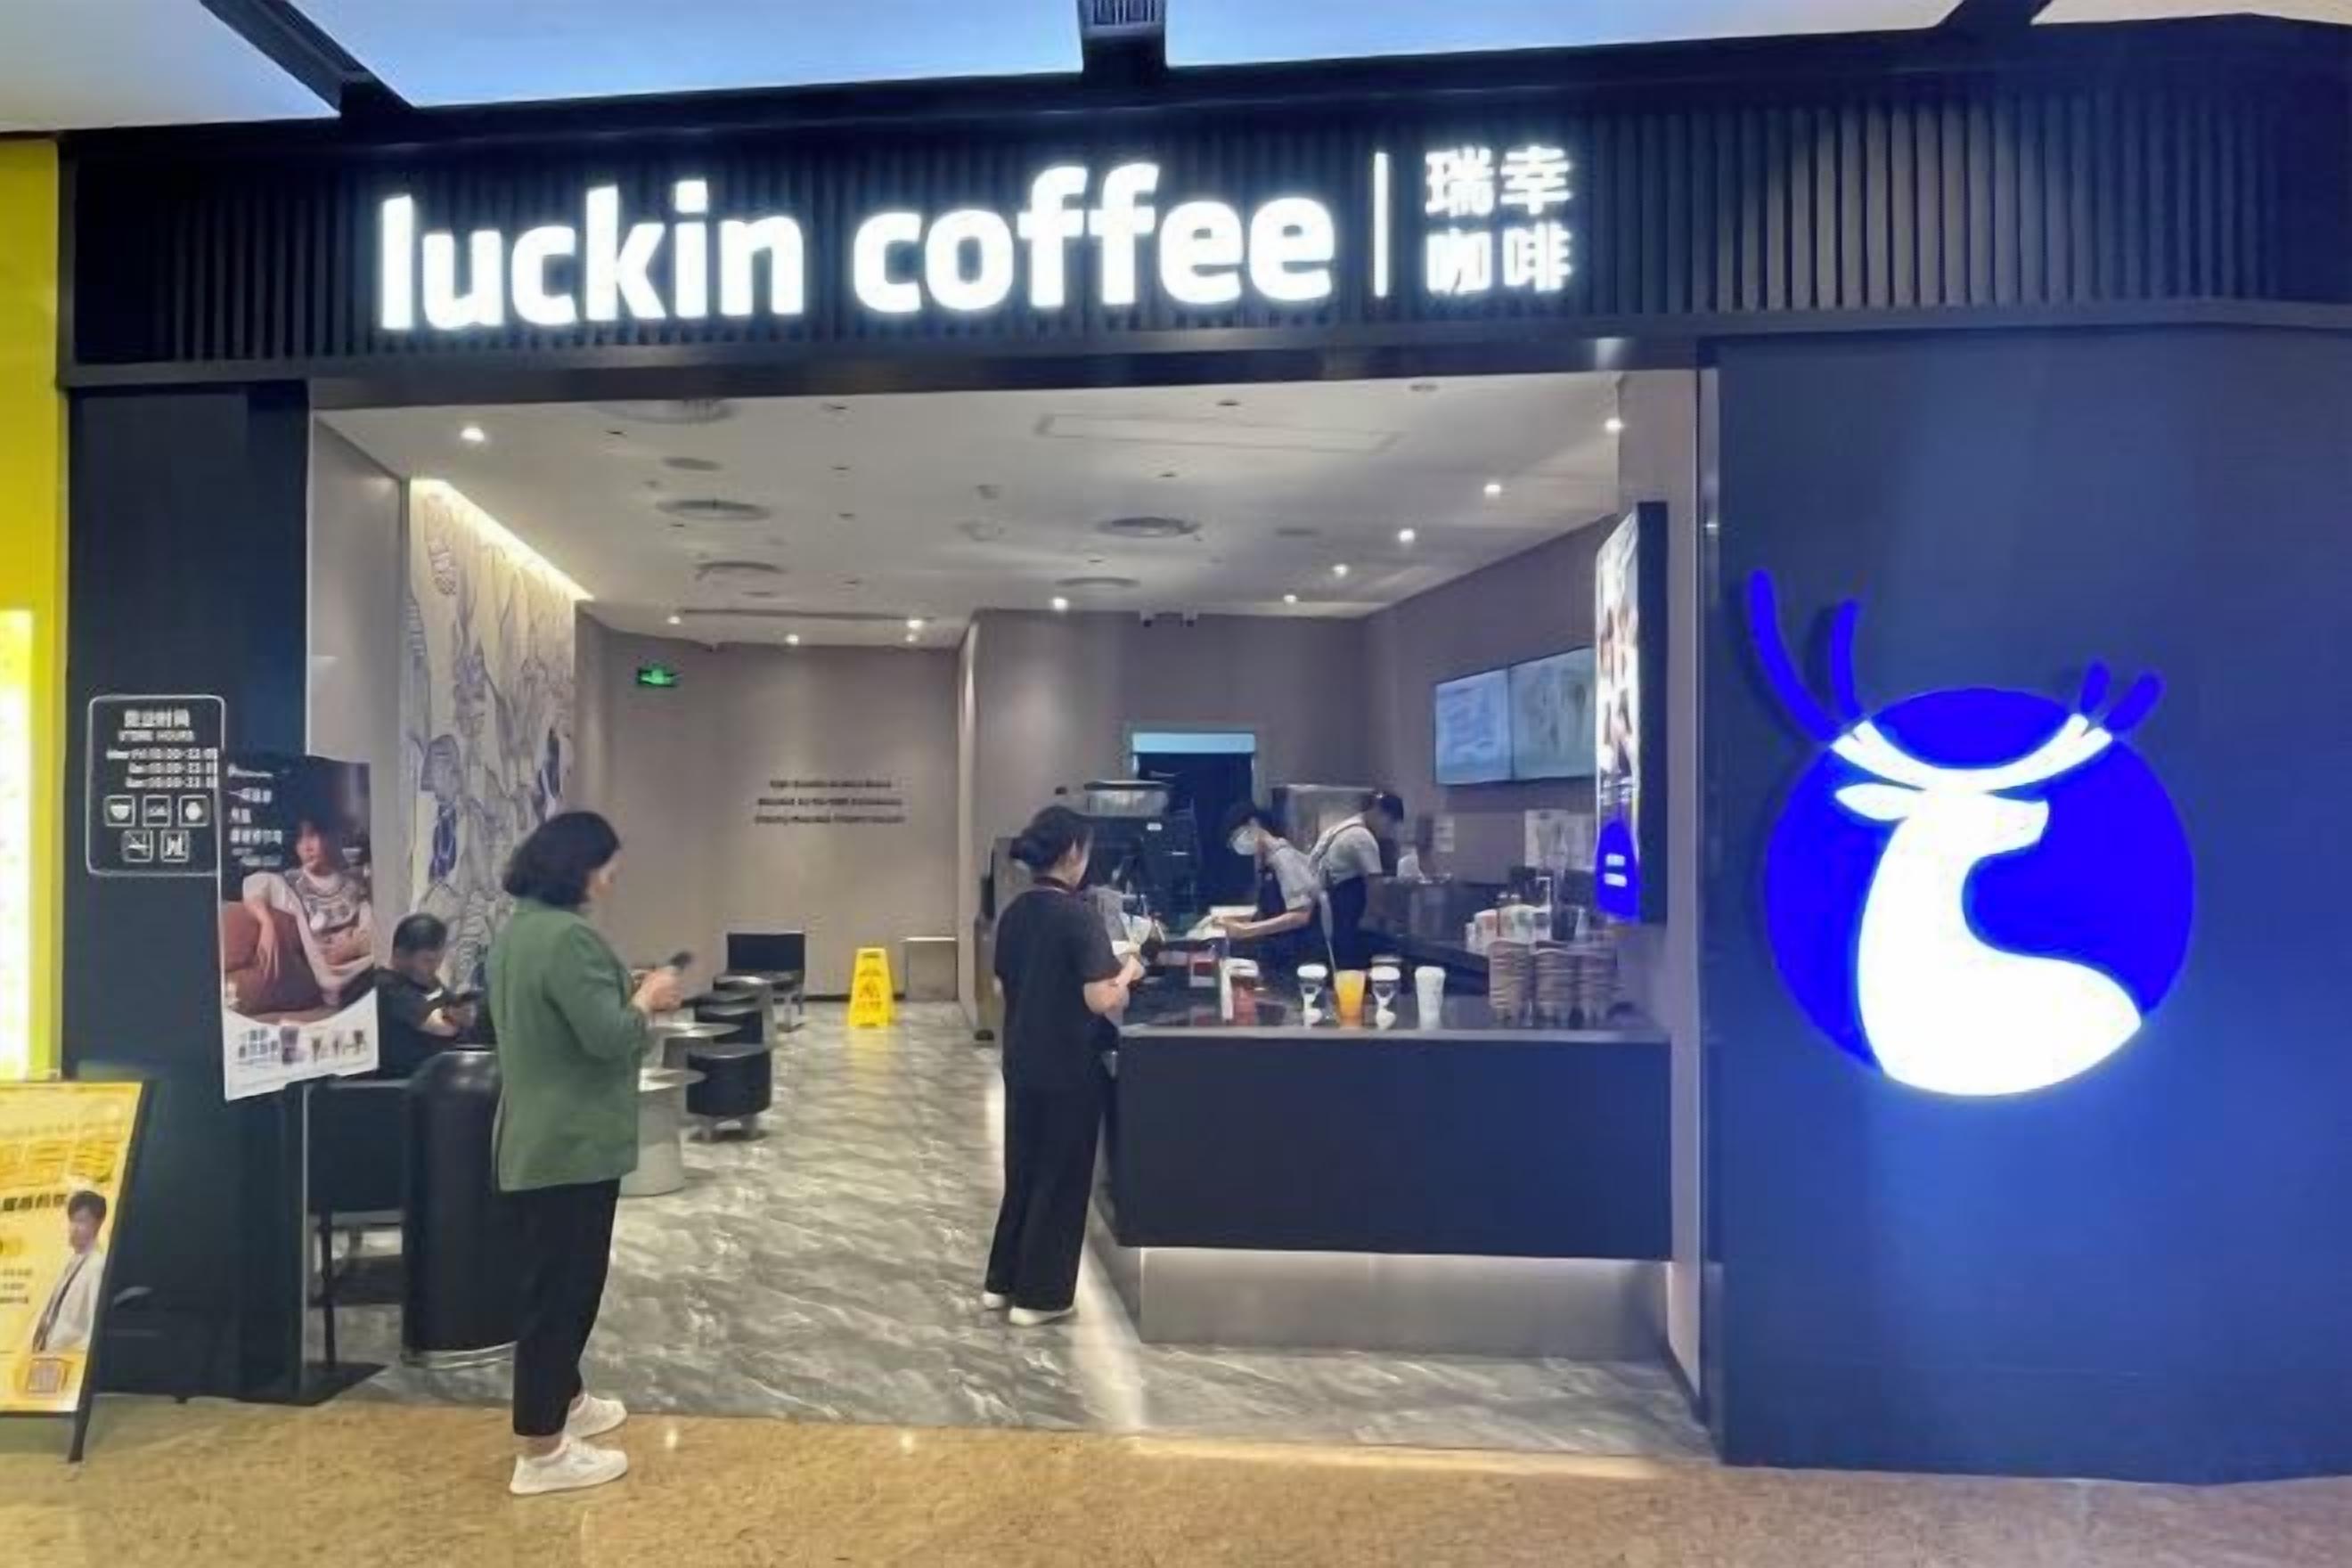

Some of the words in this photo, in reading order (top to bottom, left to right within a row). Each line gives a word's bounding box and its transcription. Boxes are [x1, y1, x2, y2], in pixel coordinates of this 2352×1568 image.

[1425, 145, 1571, 217] 瑞幸
[382, 180, 804, 331] luckin
[853, 163, 1335, 313] coffee
[1426, 221, 1572, 295] 咖啡
